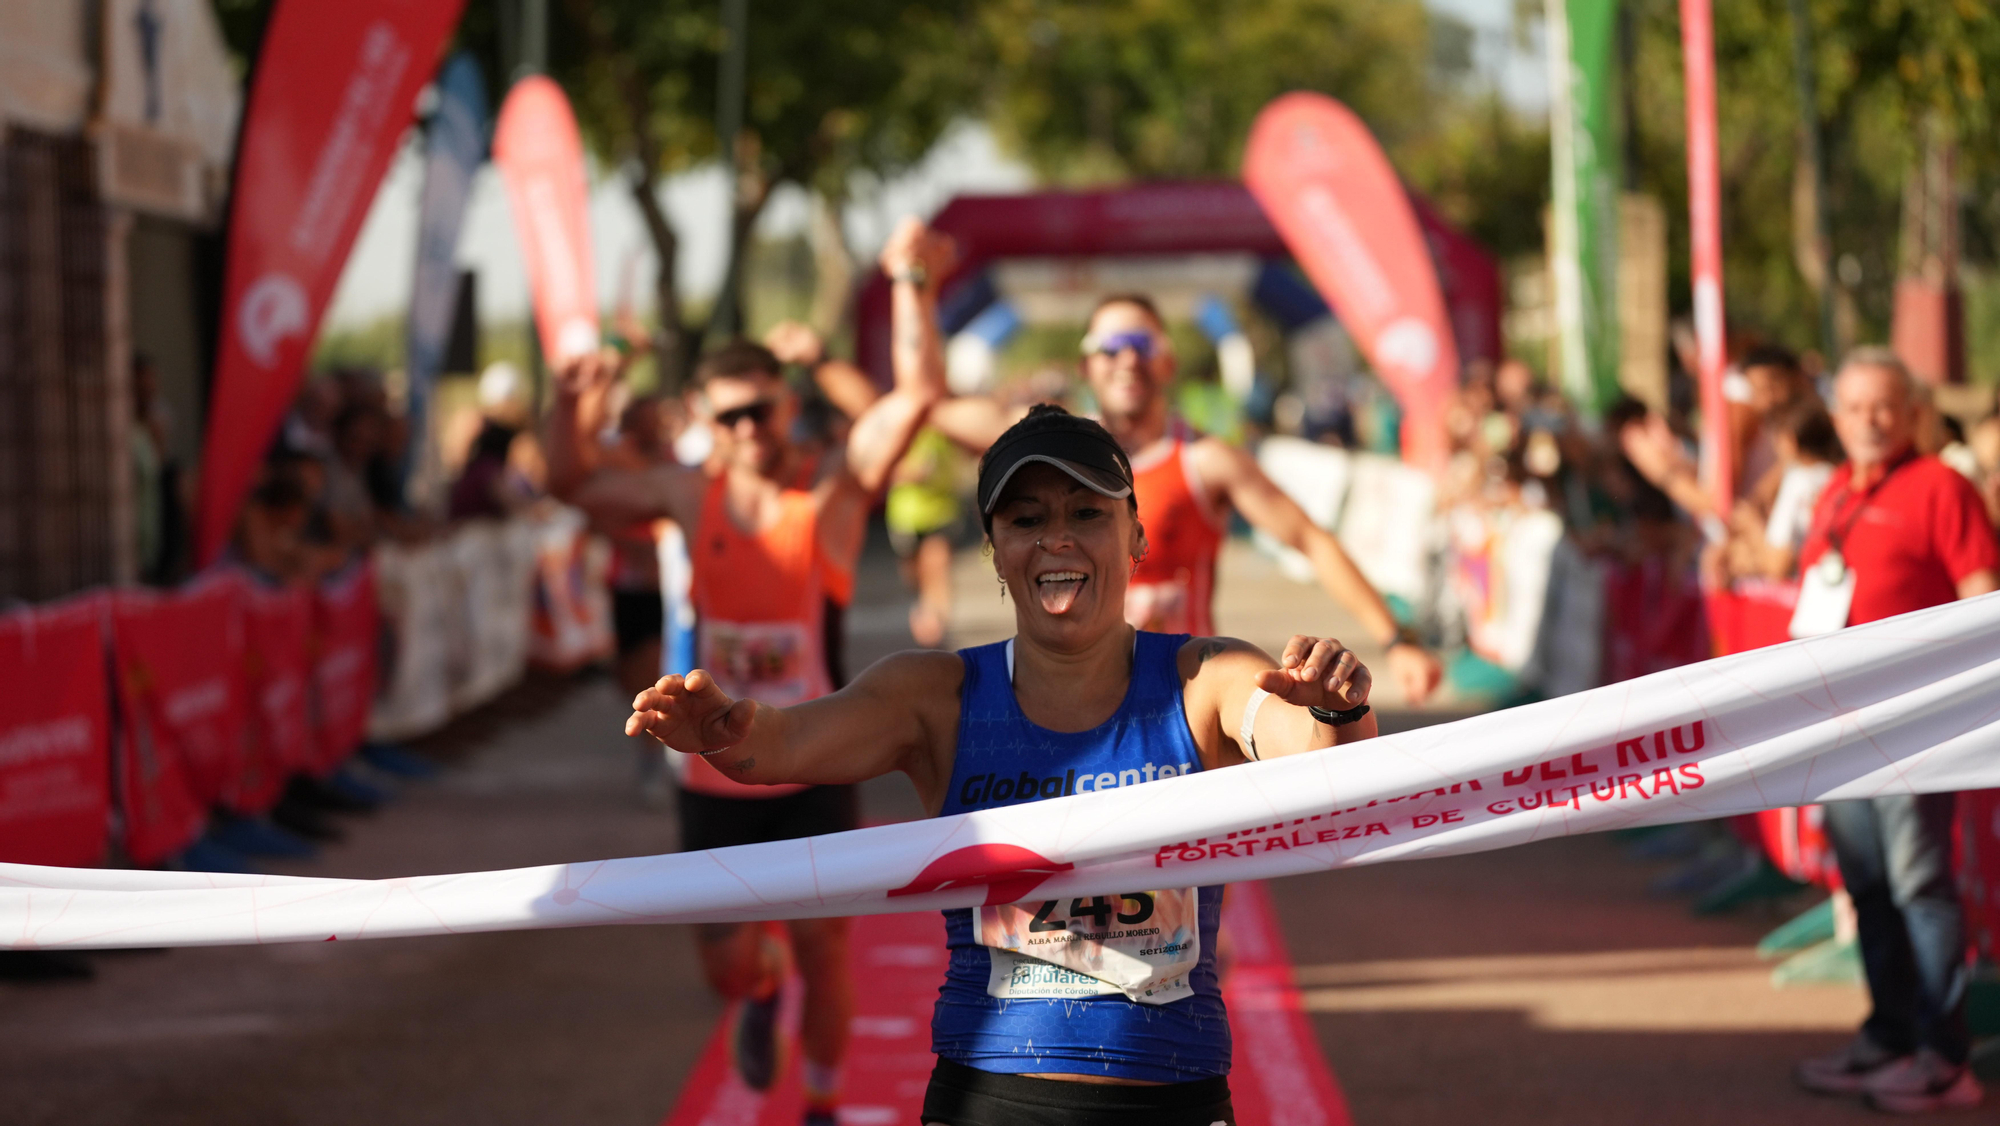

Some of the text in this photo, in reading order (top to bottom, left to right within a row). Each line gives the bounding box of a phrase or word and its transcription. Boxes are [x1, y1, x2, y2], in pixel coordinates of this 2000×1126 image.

[960, 762, 1192, 806] Globalcenter
[1155, 822, 1391, 868] FORTALEZA
[1412, 809, 1465, 829] DE
[1486, 762, 1705, 815] CULTURAS
[1027, 938, 1051, 946] ALBA
[1083, 930, 1124, 941] REGUILLO
[1126, 927, 1160, 938] MORENO
[1139, 943, 1188, 956] serizona
[1010, 970, 1099, 988] populares
[1009, 986, 1099, 995] Diputación de Córdoba
